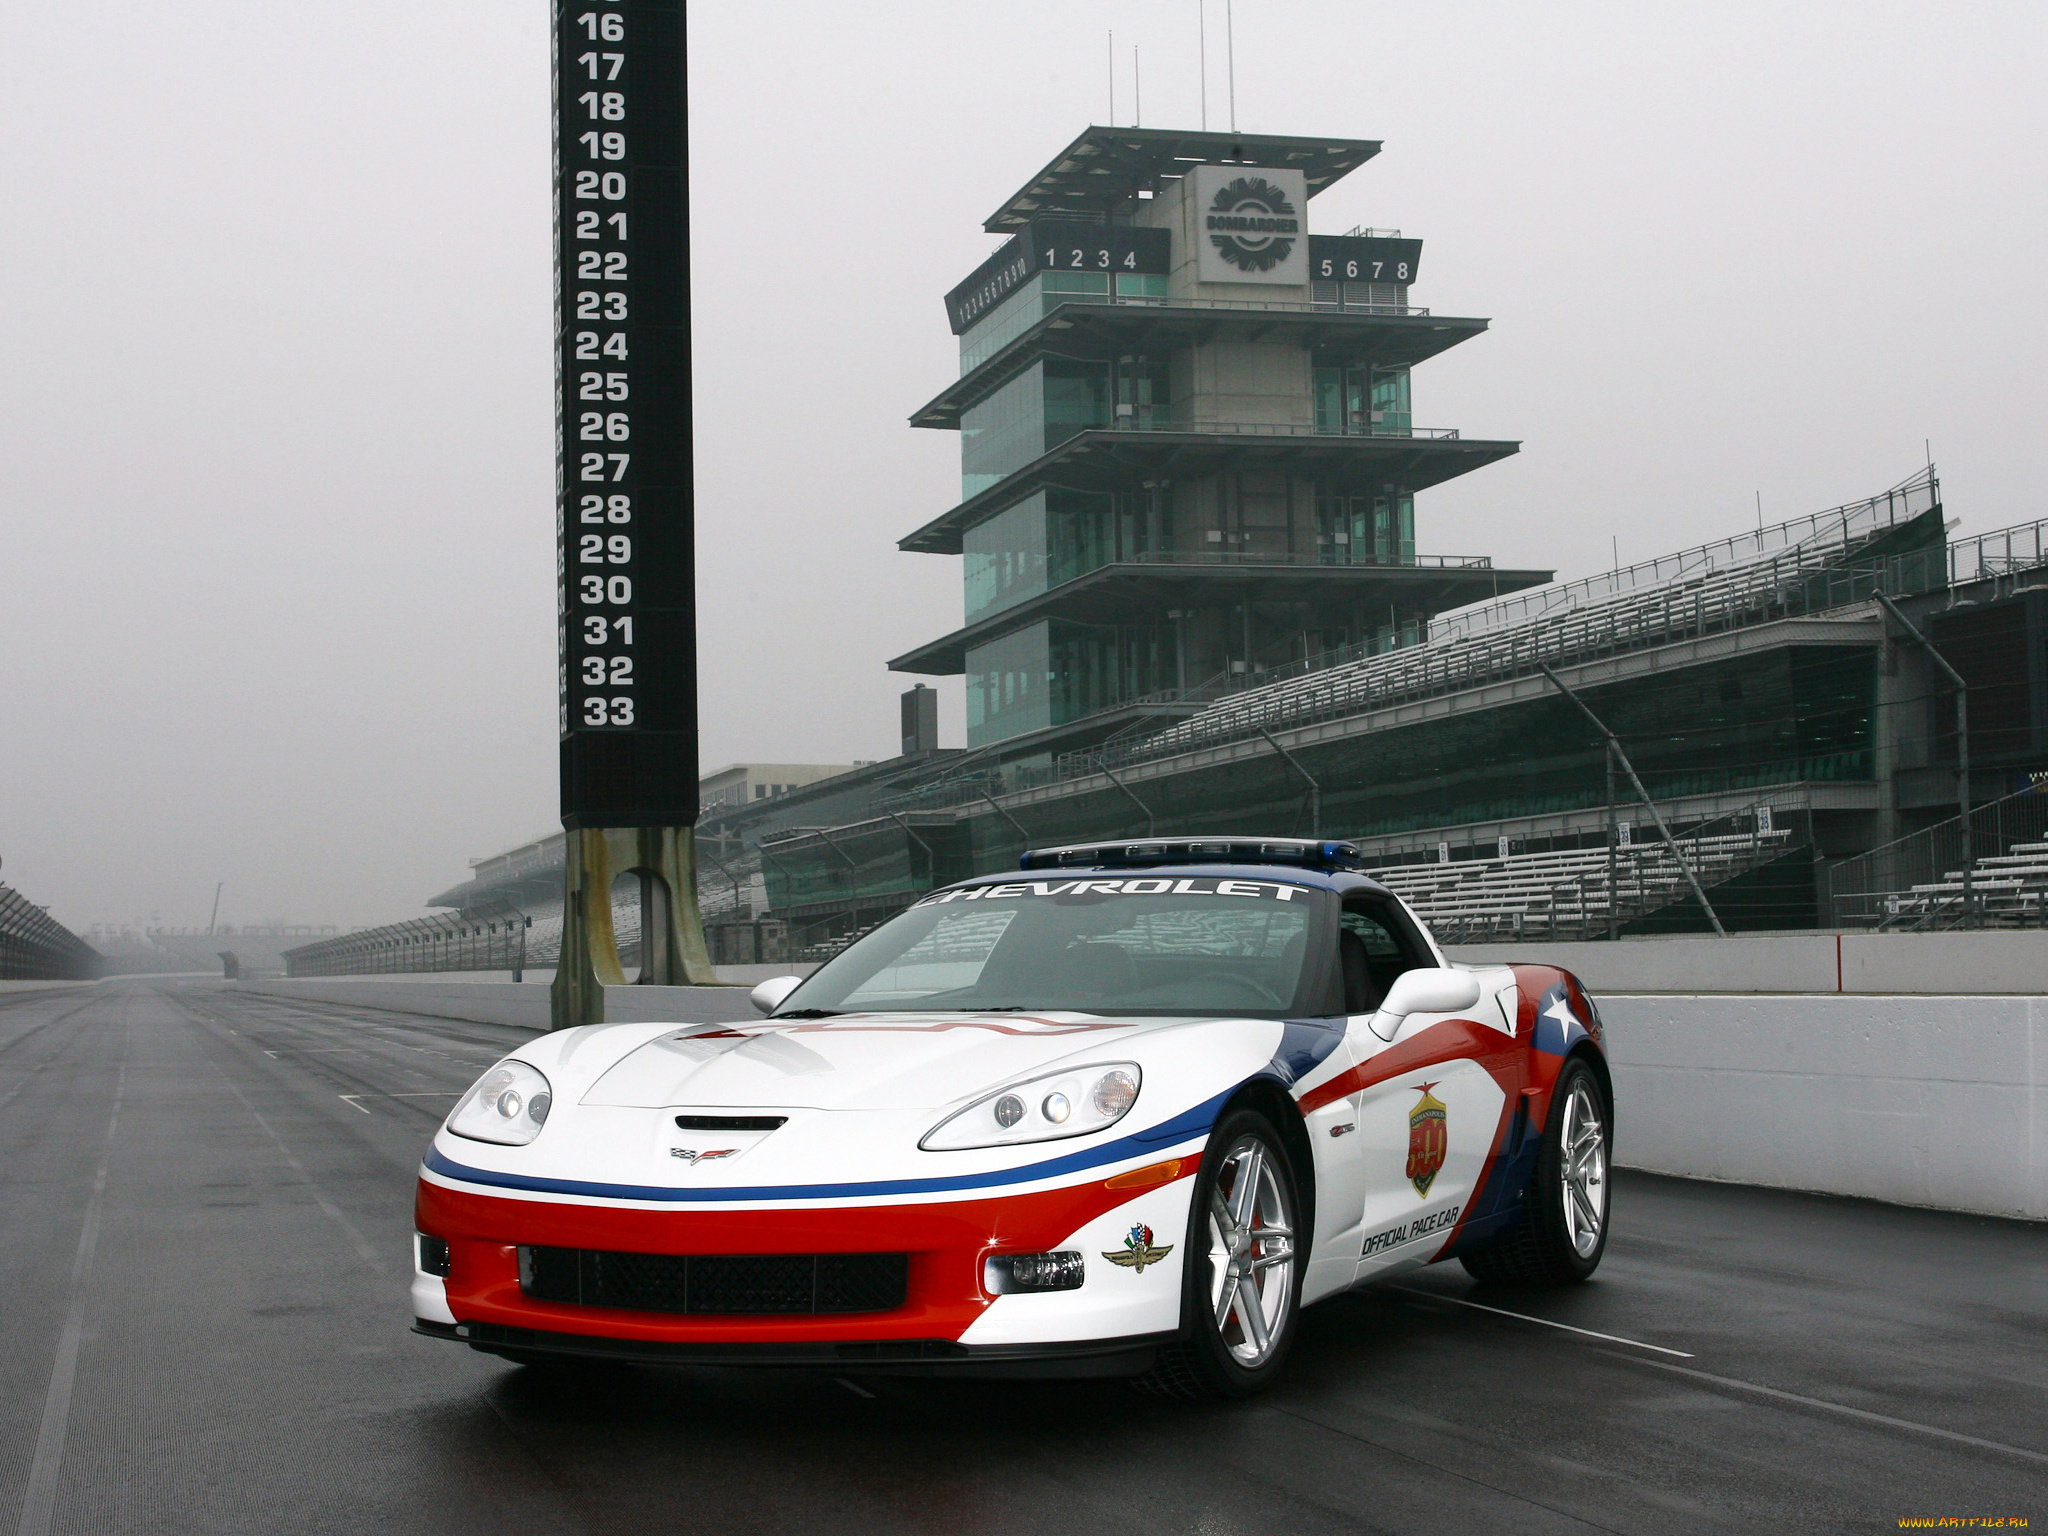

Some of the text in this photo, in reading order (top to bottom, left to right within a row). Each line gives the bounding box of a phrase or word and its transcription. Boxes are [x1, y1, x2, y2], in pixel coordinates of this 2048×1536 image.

[577, 13, 624, 41] 16
[577, 52, 624, 80] 17
[578, 92, 625, 120] 18
[578, 132, 625, 160] 19
[576, 171, 626, 200] 20
[576, 211, 627, 240] 21
[1207, 215, 1299, 234] BOMBARDIER
[578, 251, 627, 280] 22
[1046, 248, 1136, 269] 1 2 3 4
[1321, 259, 1408, 280] 5 6 7 8
[960, 258, 1026, 324] 1 2 3 4 5 6 7 8 9 10
[577, 291, 628, 320] 23
[576, 332, 628, 360] 24
[580, 372, 628, 401] 25
[580, 412, 629, 441] 26
[580, 453, 630, 481] 27
[580, 495, 631, 523] 28
[580, 535, 631, 564] 29
[580, 576, 632, 604] 30
[584, 616, 633, 645] 31
[582, 657, 633, 685] 32
[584, 697, 634, 725] 33
[907, 880, 1310, 911] CHEVROLET
[1362, 1206, 1459, 1255] OFFICIAL PACE CAR
